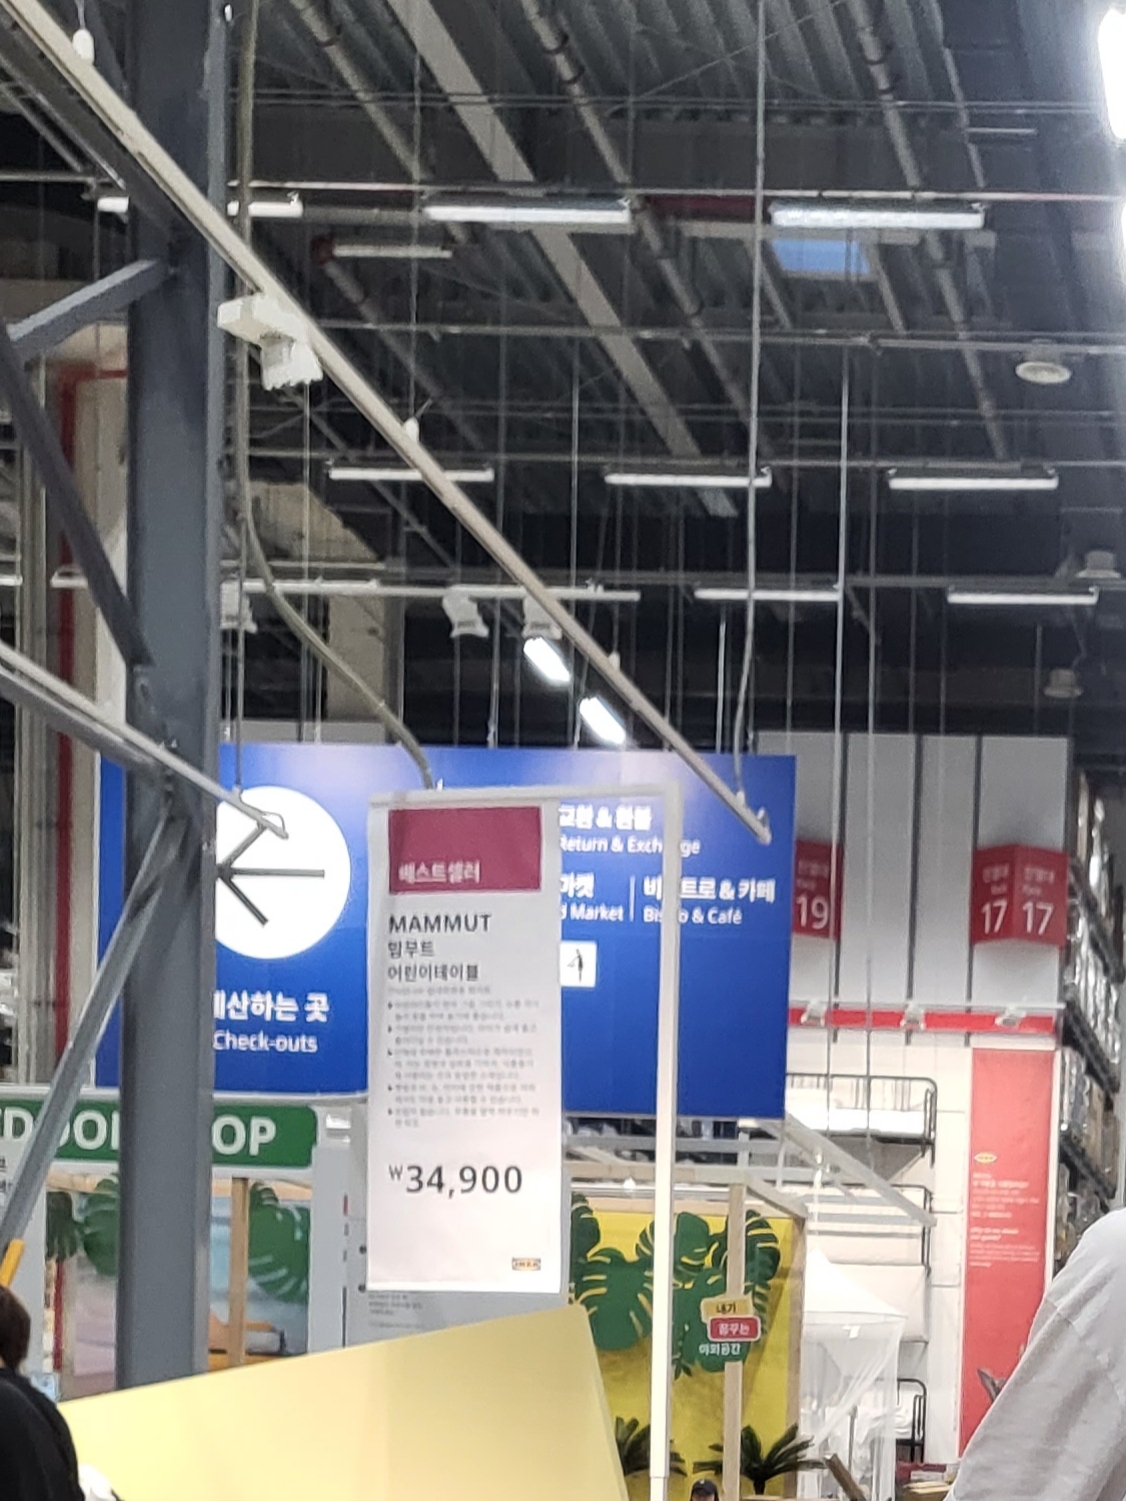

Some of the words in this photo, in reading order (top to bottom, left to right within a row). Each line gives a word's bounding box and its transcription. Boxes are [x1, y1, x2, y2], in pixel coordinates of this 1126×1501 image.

[596, 806, 611, 828] &
[560, 836, 608, 853] Return
[611, 838, 624, 852] &
[627, 837, 700, 856] Exchge
[398, 860, 481, 885] 베스트셀러
[643, 876, 716, 900] 비트로
[719, 879, 735, 899] &
[738, 877, 776, 903] 카페
[388, 914, 492, 934] MAMMUT
[570, 903, 624, 921] Market
[643, 907, 688, 924] Biso
[692, 908, 704, 924] &
[707, 906, 742, 925] Café
[796, 896, 830, 929] 19
[981, 898, 1008, 934] 17
[1022, 902, 1054, 935] 17
[387, 963, 480, 983] 어린이테이블
[305, 992, 330, 1022] 곳
[212, 1029, 318, 1053] Check-outs
[211, 1114, 277, 1156] OP
[716, 1302, 736, 1314] 내가
